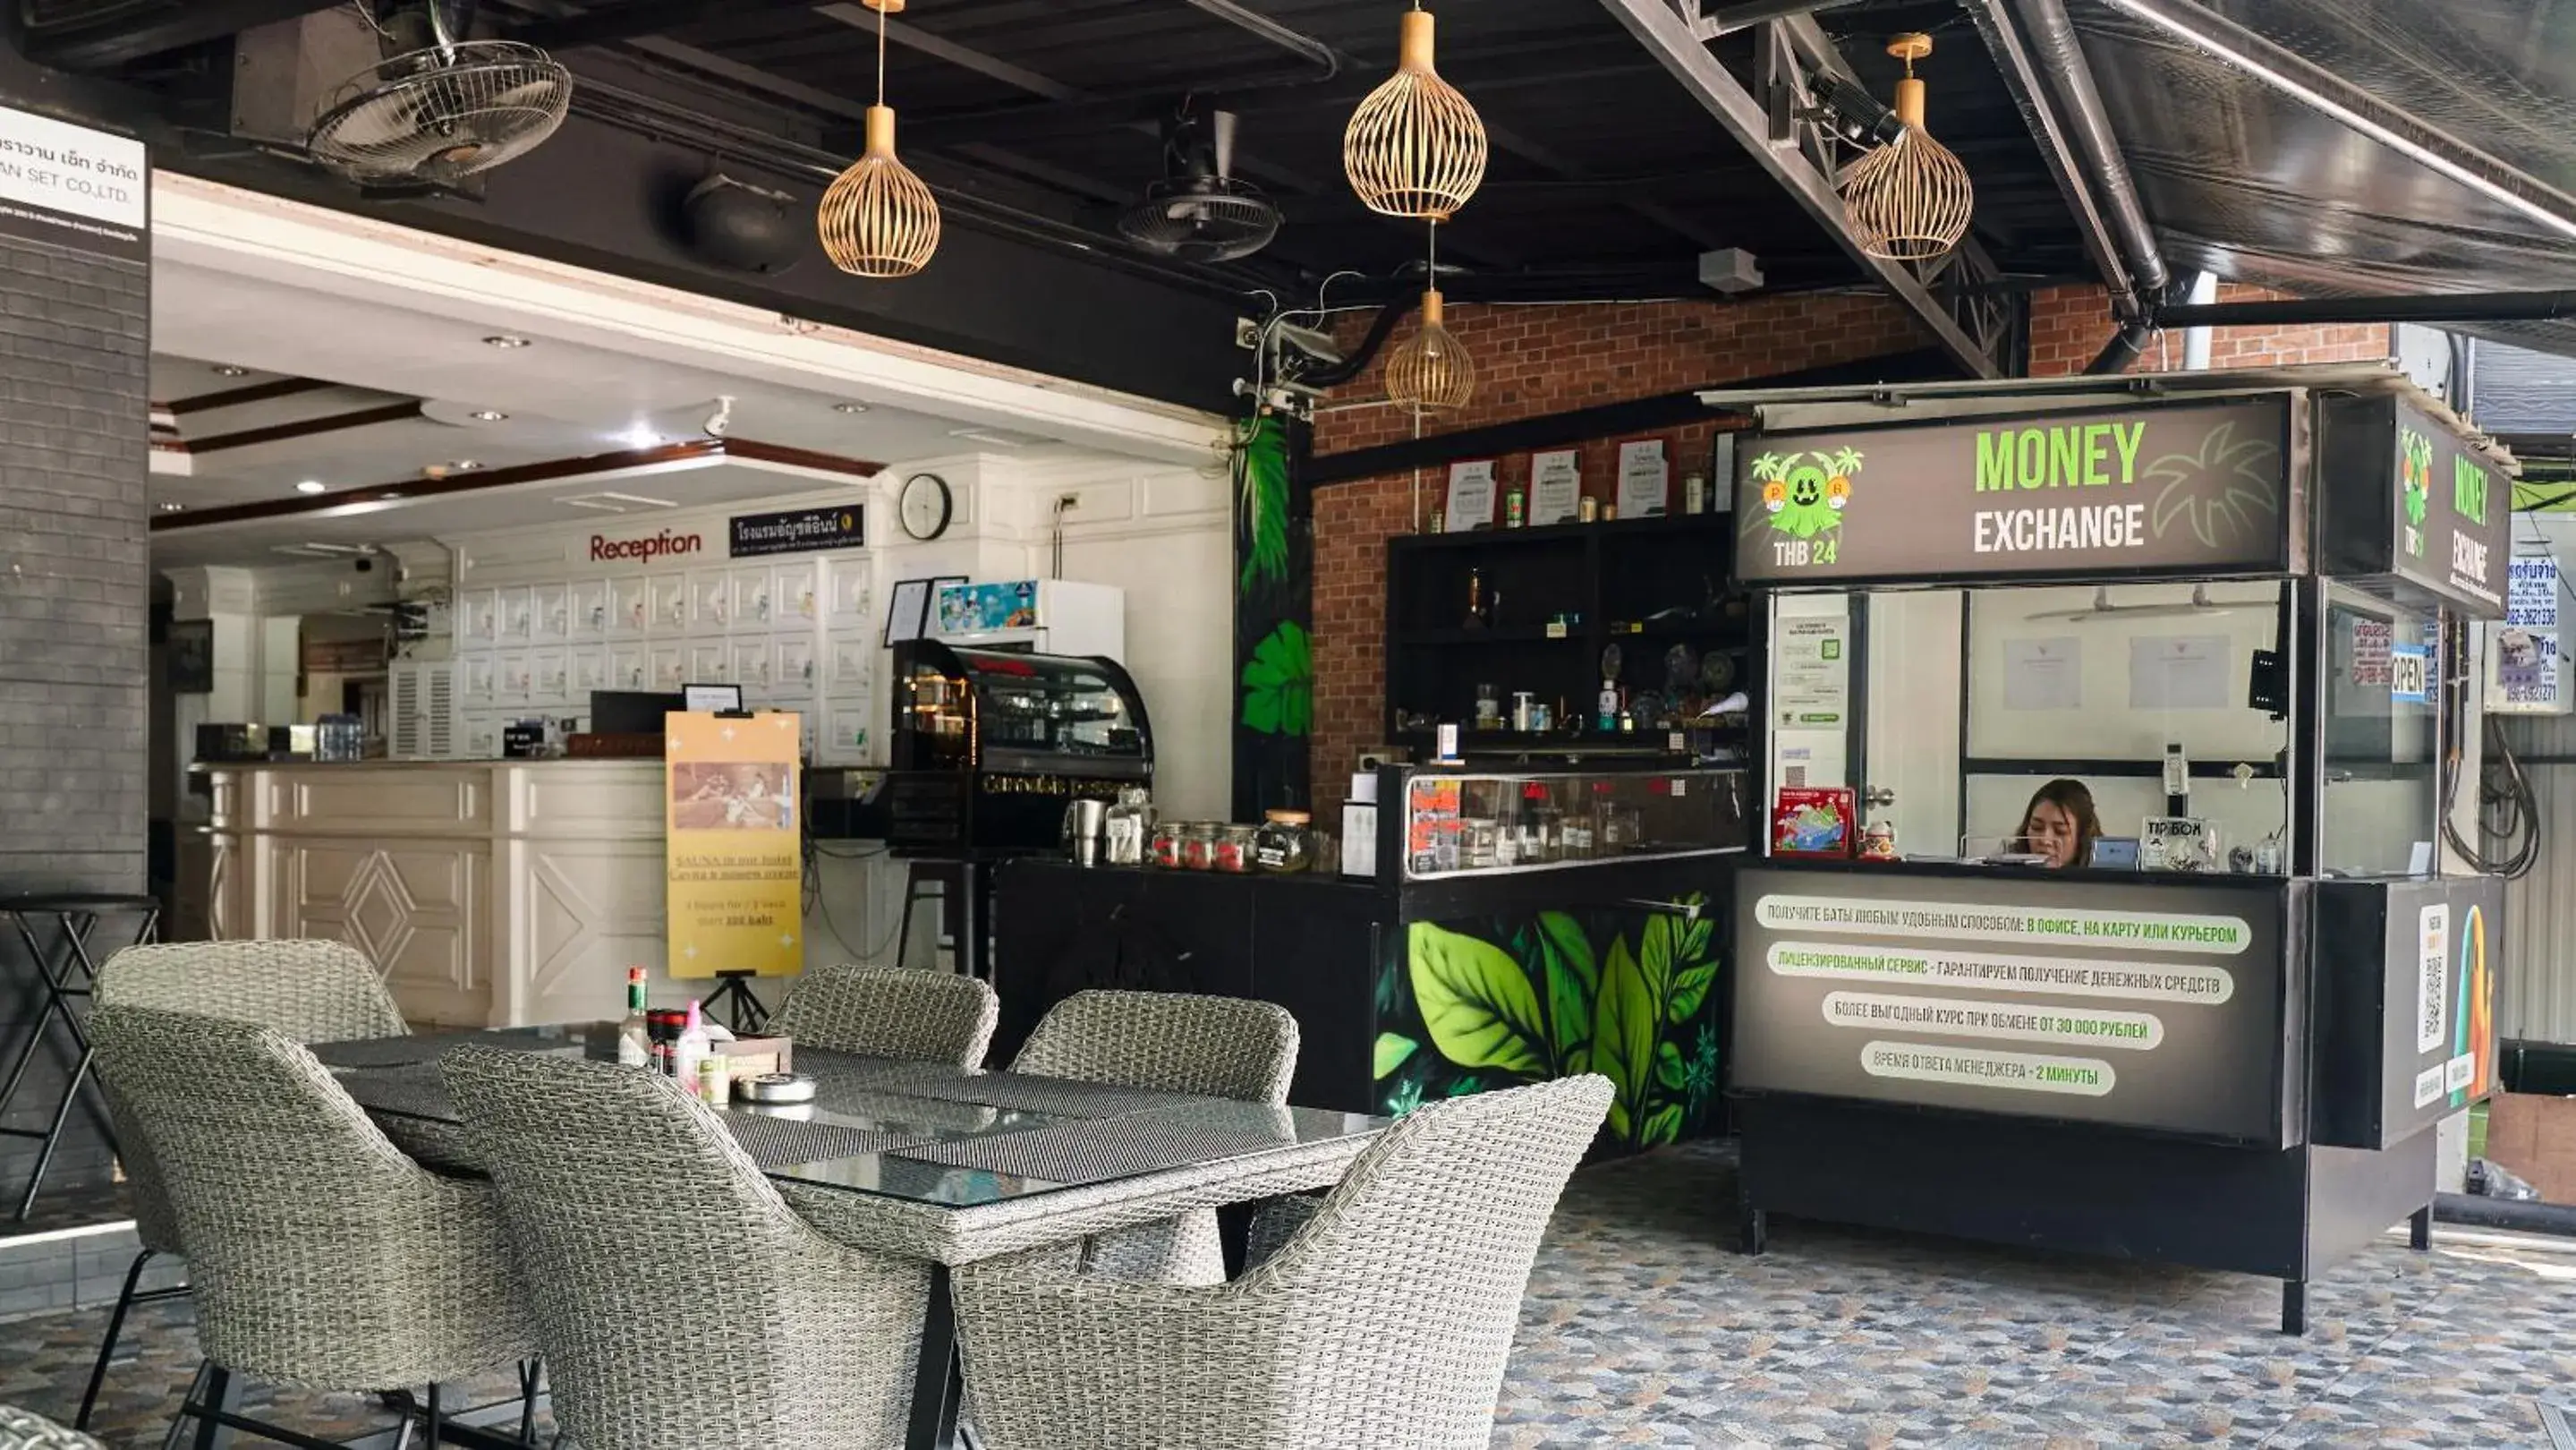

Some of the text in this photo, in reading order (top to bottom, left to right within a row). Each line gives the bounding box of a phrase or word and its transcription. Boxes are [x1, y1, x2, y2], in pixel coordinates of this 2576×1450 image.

[28, 168, 59, 188] SET
[1976, 421, 2146, 491] MONEY
[2454, 452, 2487, 527] MONEY
[591, 528, 701, 563] Reception
[1975, 504, 2144, 552] EXCHANGE
[1773, 540, 1836, 566] THB 24
[2393, 656, 2422, 692] OPEN
[1768, 905, 2237, 942] ПОЛУЧИТЕ БАТЫ ЛЮБЫМ УДОБНЫМ СПОСОБОМ: В ОФИСЕ, НА КАРТУ ИЛИ КУРЬЕРОМ
[1778, 951, 1884, 971] ЛИЦЕНЗИРОВАННЫЙ
[1887, 958, 1927, 974] СЕРВИС
[1937, 960, 2017, 981] ГАРАНТИРУЕМ
[2019, 966, 2088, 985] ПОЛУЧЕНИЕ
[2091, 970, 2162, 989] ДЕНЕЖНЫХ
[2164, 975, 2220, 994] СРЕДСТВ
[1835, 1001, 2147, 1039] БОЛЕЕ ВЫГОДНЫЙ КУРС ПРИ ОБМЕНЕ ОТ 30 000 РУБЛЕЙ
[1875, 1051, 1909, 1068] ВРЕМЯ
[1912, 1055, 1952, 1072] ОТВЕТА
[1953, 1059, 2026, 1079] МЕНЕДЖЕРА
[2036, 1065, 2045, 1079] 2
[2046, 1066, 2098, 1086] МИНУТЫ
